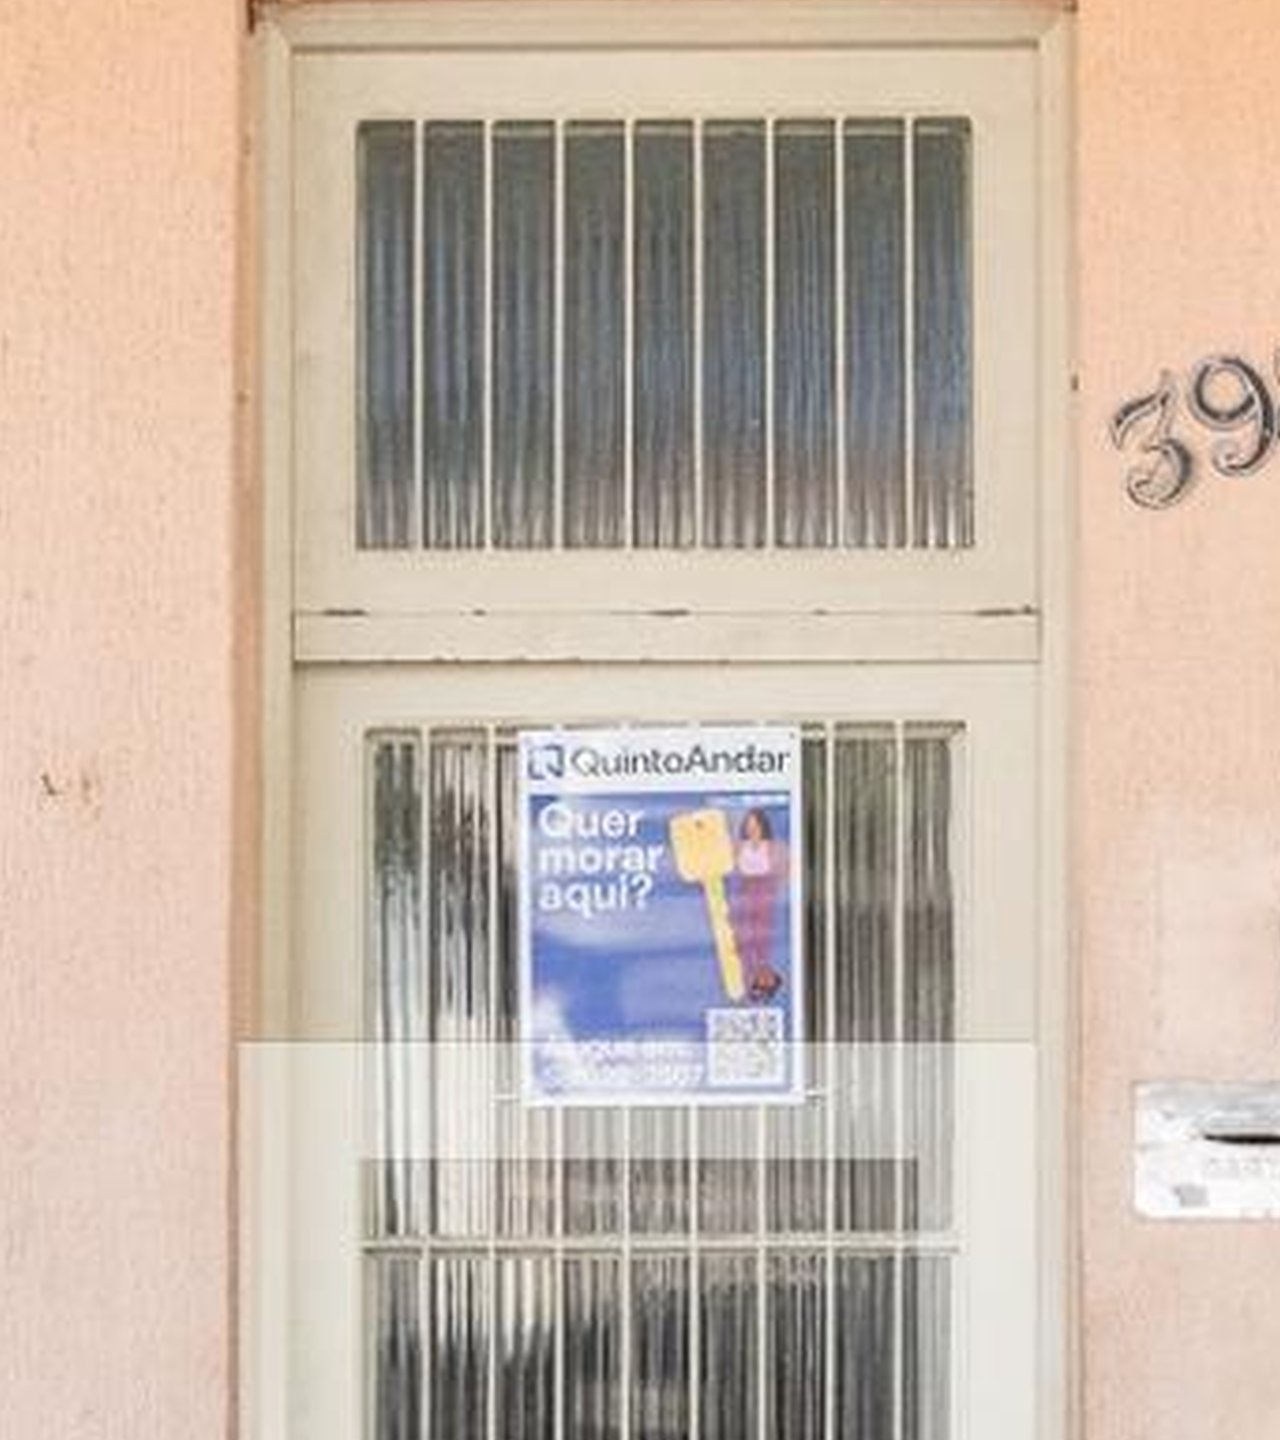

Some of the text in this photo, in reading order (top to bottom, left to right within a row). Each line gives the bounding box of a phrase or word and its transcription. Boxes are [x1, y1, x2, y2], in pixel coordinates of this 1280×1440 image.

[569, 744, 792, 777] QuintoAndar
[537, 802, 645, 840] Quer
[538, 844, 663, 875] morar
[538, 874, 654, 918] aqui?
